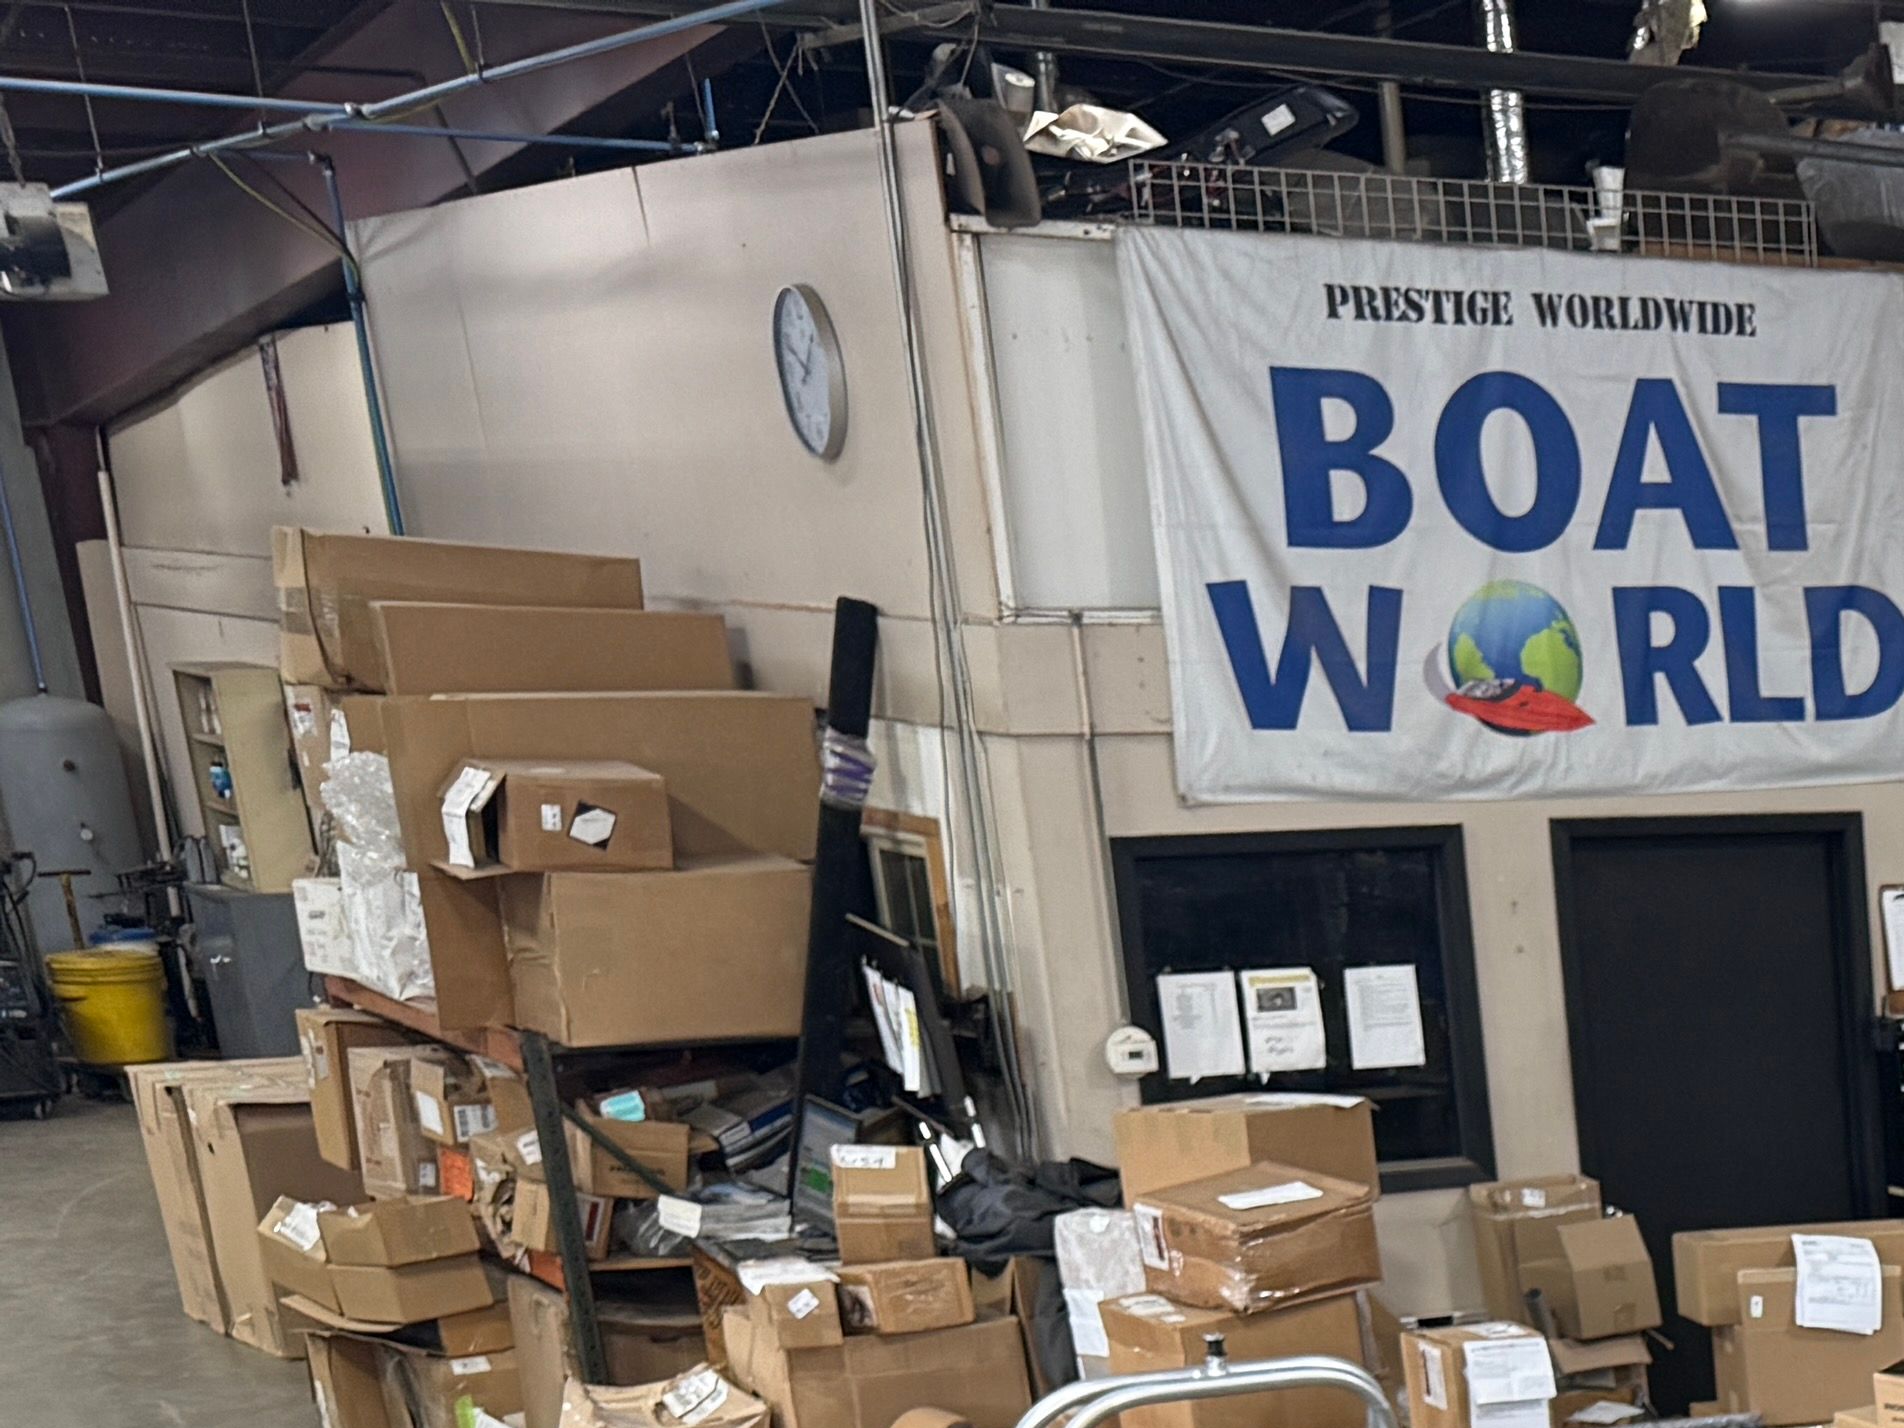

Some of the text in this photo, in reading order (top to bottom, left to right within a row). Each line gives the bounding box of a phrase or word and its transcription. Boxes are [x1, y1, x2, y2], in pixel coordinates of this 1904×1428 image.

[1324, 283, 1757, 338] PRESTIGE WORLDWIDE
[1269, 366, 1837, 553] BOAT
